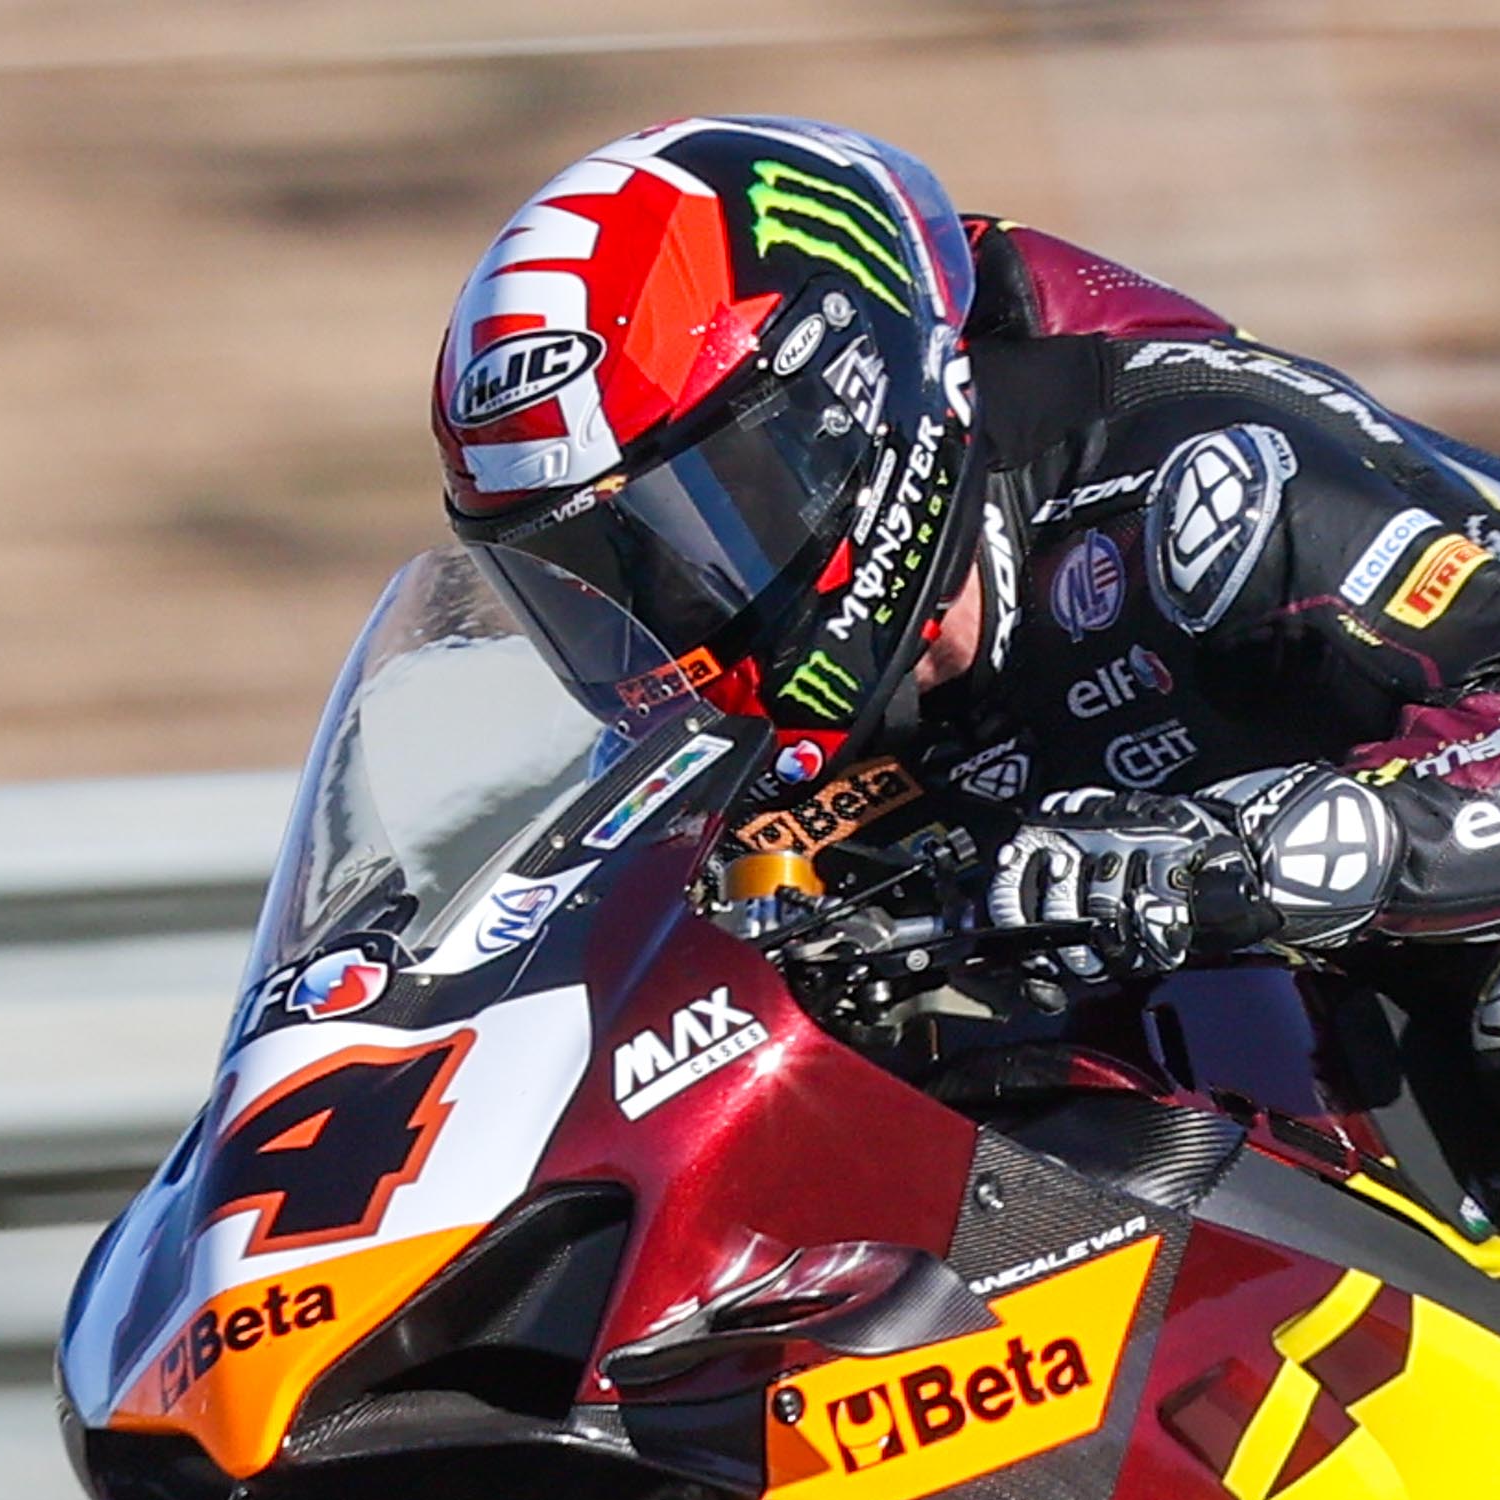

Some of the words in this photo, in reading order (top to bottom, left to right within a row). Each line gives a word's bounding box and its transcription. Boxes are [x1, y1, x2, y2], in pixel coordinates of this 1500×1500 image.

[463, 337, 575, 416] HJC
[779, 320, 821, 368] HJC
[826, 415, 946, 640] MONSTER
[1067, 653, 1136, 719] elf
[1119, 726, 1199, 778] CHT
[614, 986, 755, 1102] MAX
[690, 1028, 760, 1074] CASES
[188, 1280, 337, 1382] Beta
[900, 1335, 1093, 1448] Beta
